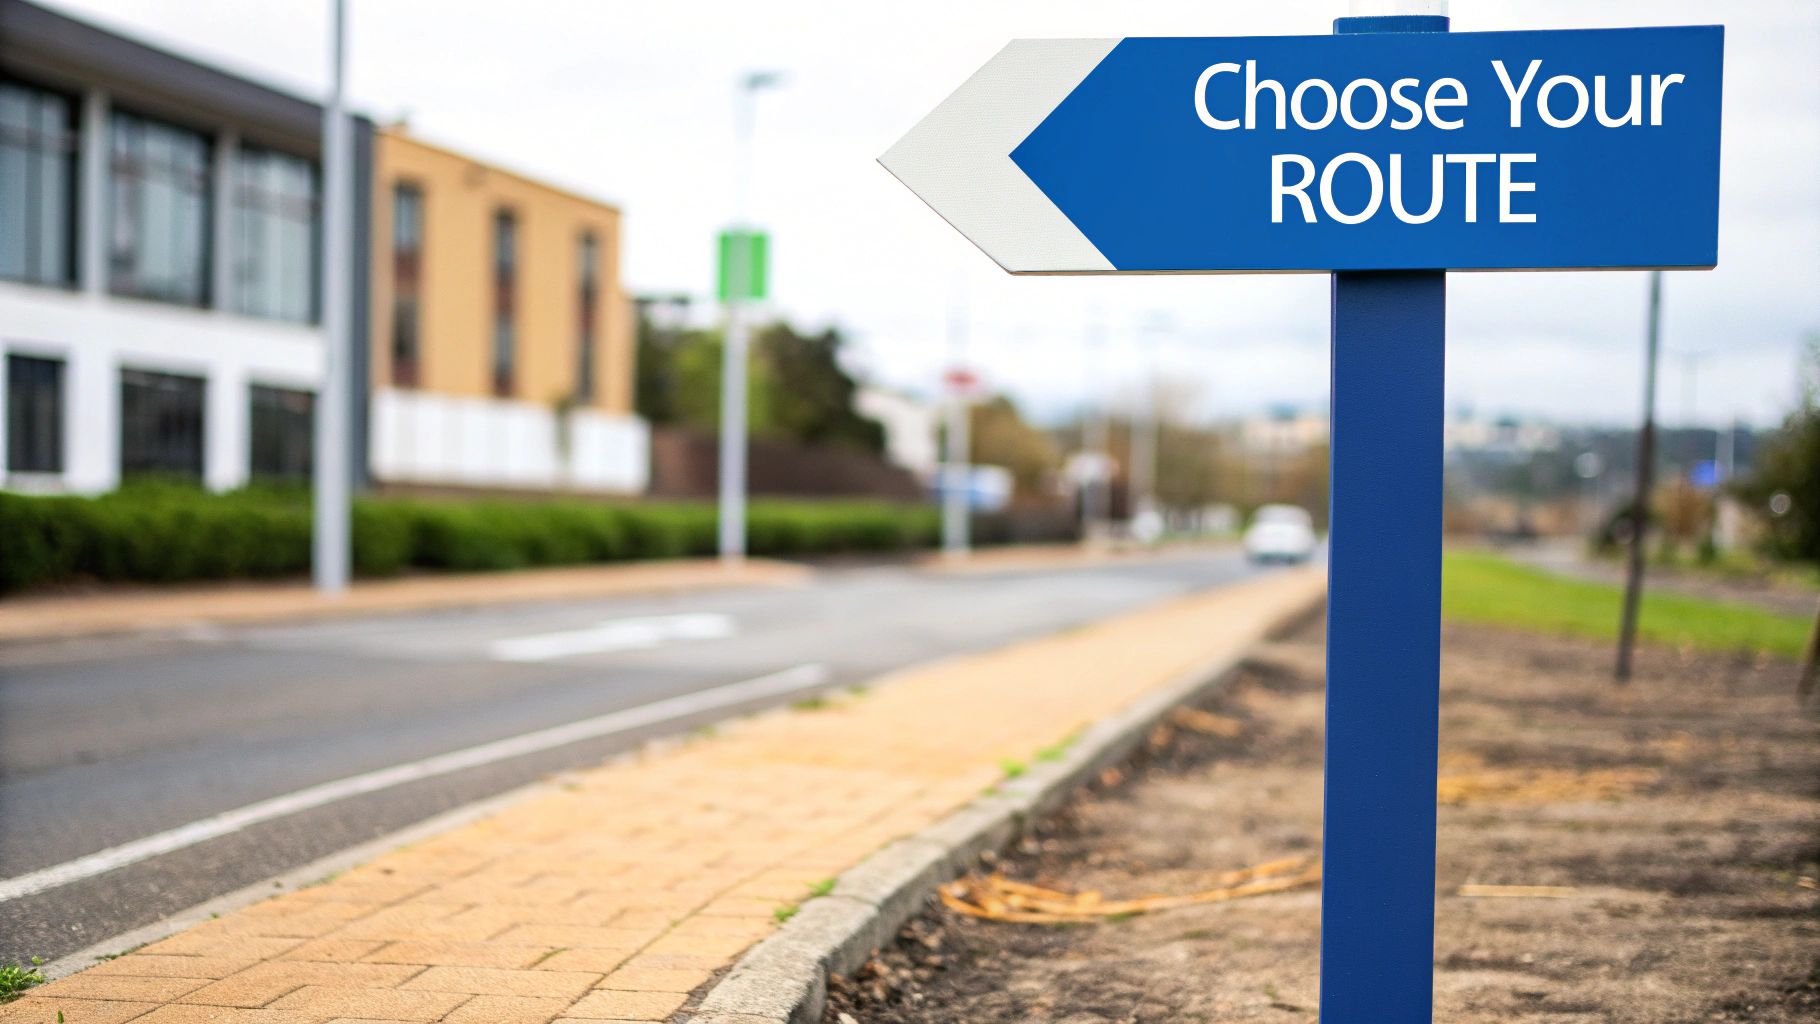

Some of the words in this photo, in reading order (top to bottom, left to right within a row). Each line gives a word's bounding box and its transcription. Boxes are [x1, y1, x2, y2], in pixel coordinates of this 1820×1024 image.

[1194, 60, 1468, 131] Choose
[1490, 59, 1686, 129] Your
[1271, 152, 1537, 225] ROUTE
